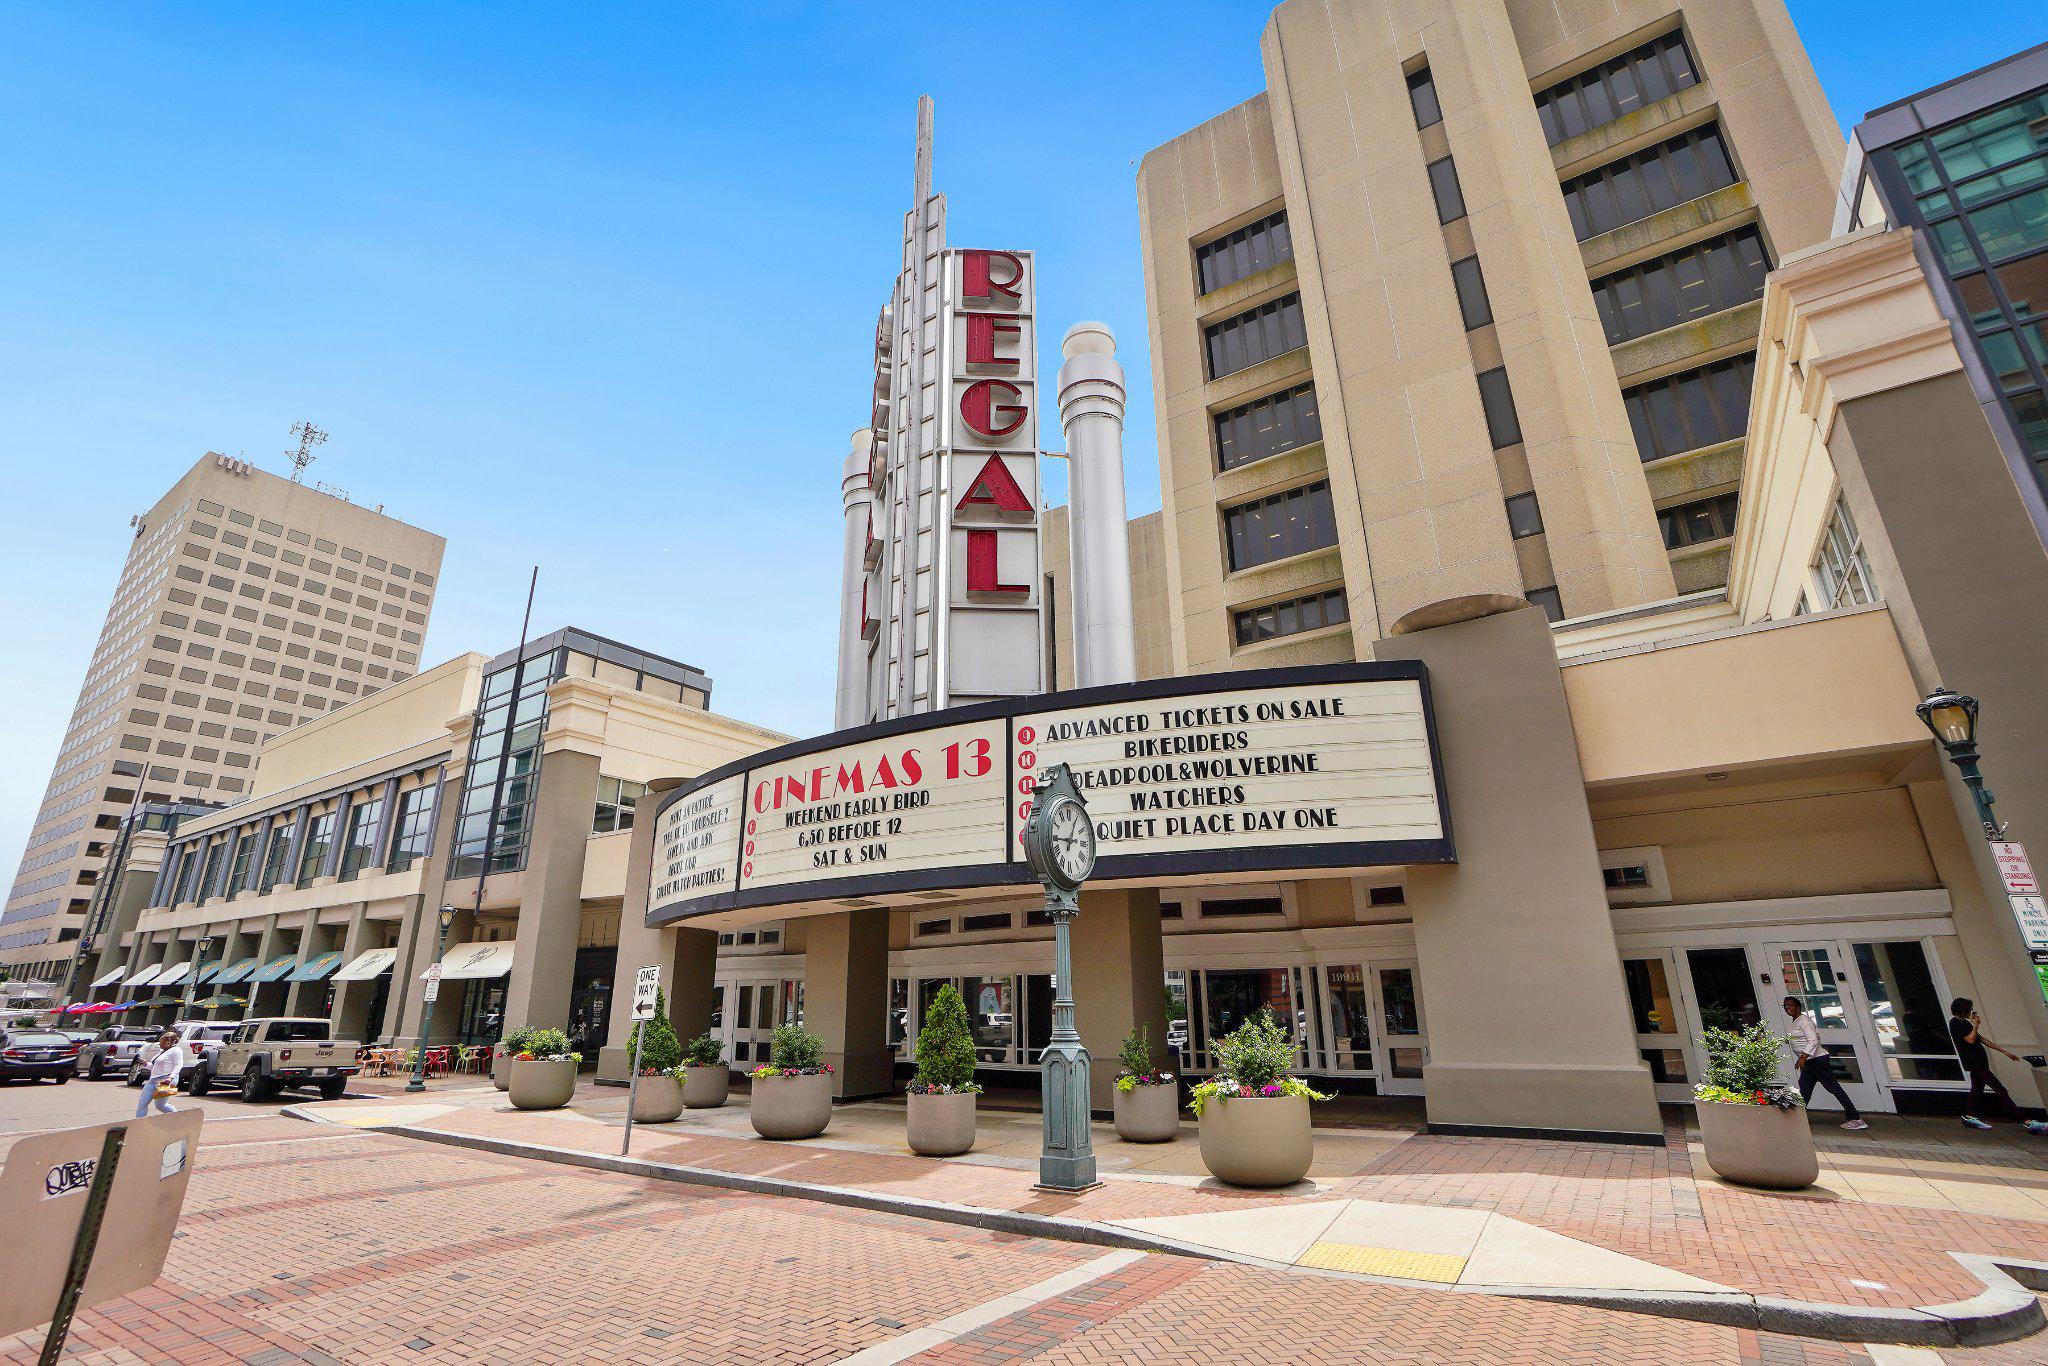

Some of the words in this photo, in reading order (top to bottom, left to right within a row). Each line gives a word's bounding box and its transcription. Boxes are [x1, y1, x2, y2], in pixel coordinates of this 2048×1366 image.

[955, 249, 1034, 597] REGAL
[1046, 714, 1149, 741] ADVANCED
[1160, 704, 1249, 729] TICKETS
[1256, 702, 1284, 720] ON
[1290, 698, 1345, 718] SALE
[1124, 731, 1248, 758] BIKERIDERS
[754, 749, 922, 813] CINEMAS
[941, 738, 992, 779] 13
[1073, 753, 1319, 788] DEADPOOL&WOLVERINE
[785, 803, 841, 828] WEEKEND
[844, 795, 889, 818] EARLY
[894, 790, 930, 810] BIRD
[1130, 785, 1245, 810] WATCHERS
[829, 820, 881, 843] BEFORE
[887, 817, 902, 835] 12
[1096, 818, 1156, 841] QUIET
[1166, 813, 1235, 836] PLACE
[1243, 811, 1286, 831] DAY
[1294, 808, 1339, 828] ONE
[813, 849, 837, 868] SAT
[844, 848, 853, 864] &
[860, 843, 887, 862] SUN
[692, 868, 725, 888] PARTIES!
[640, 969, 656, 982] ONE
[639, 983, 655, 996] WAY
